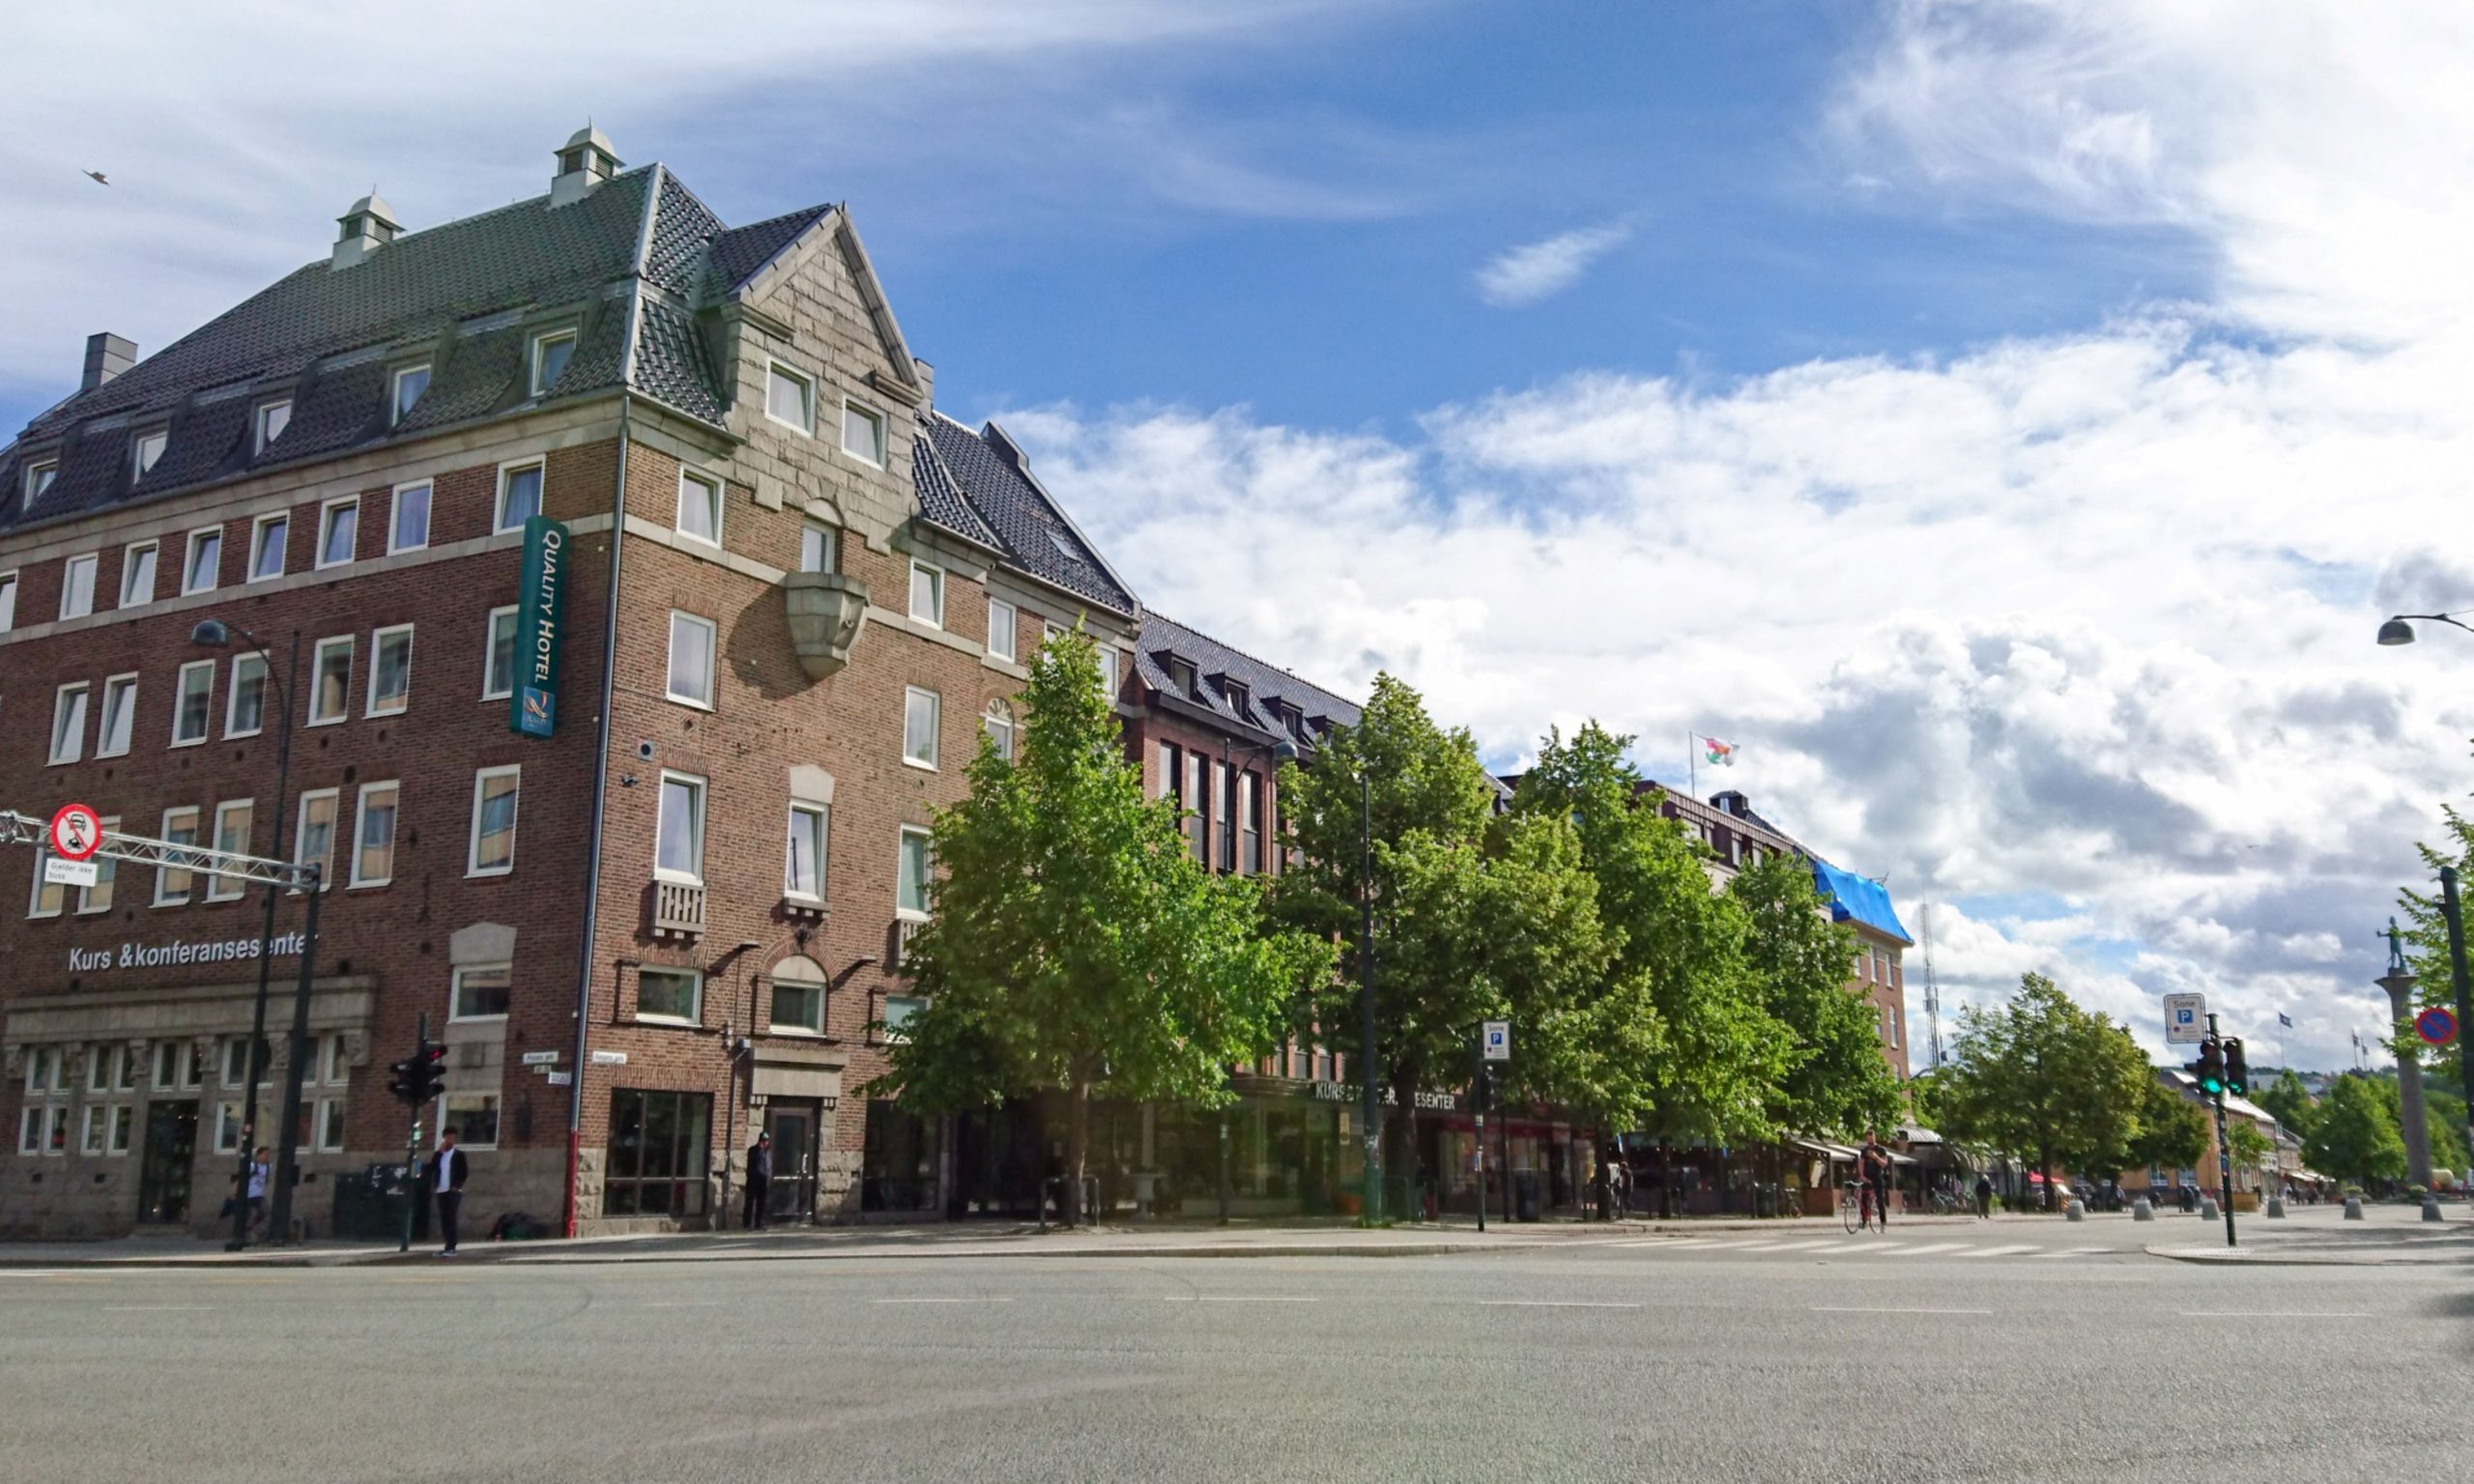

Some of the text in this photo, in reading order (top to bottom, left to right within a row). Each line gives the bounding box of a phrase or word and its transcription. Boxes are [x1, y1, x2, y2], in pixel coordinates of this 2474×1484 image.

[534, 529, 561, 683] QUALITY HOTEL
[69, 948, 111, 972] Kurs
